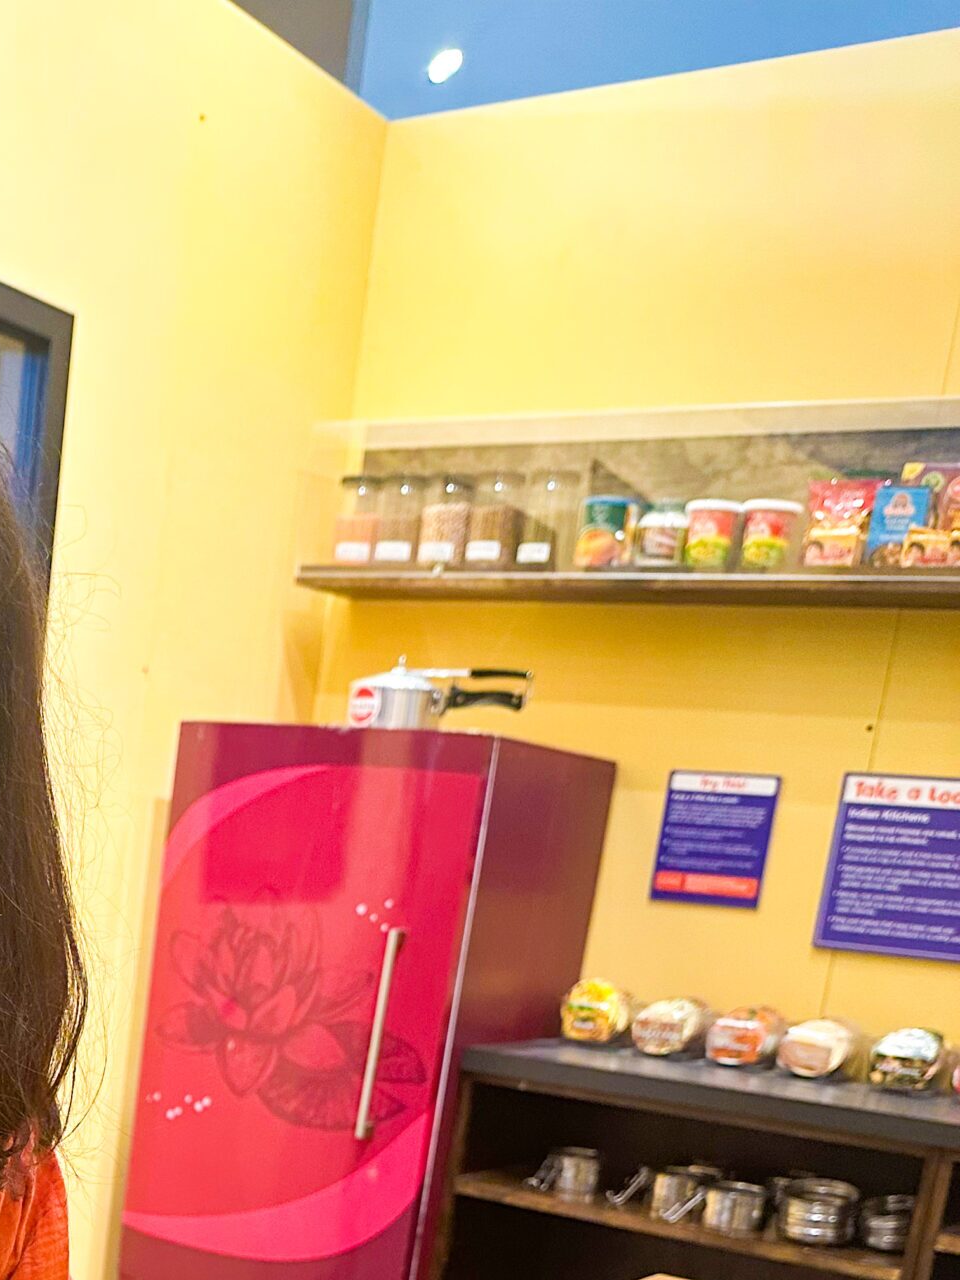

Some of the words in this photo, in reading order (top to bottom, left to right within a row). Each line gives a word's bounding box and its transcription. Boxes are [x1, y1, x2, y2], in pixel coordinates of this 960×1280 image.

[855, 780, 898, 801] Take
[907, 787, 921, 800] a
[929, 787, 960, 803] Loo
